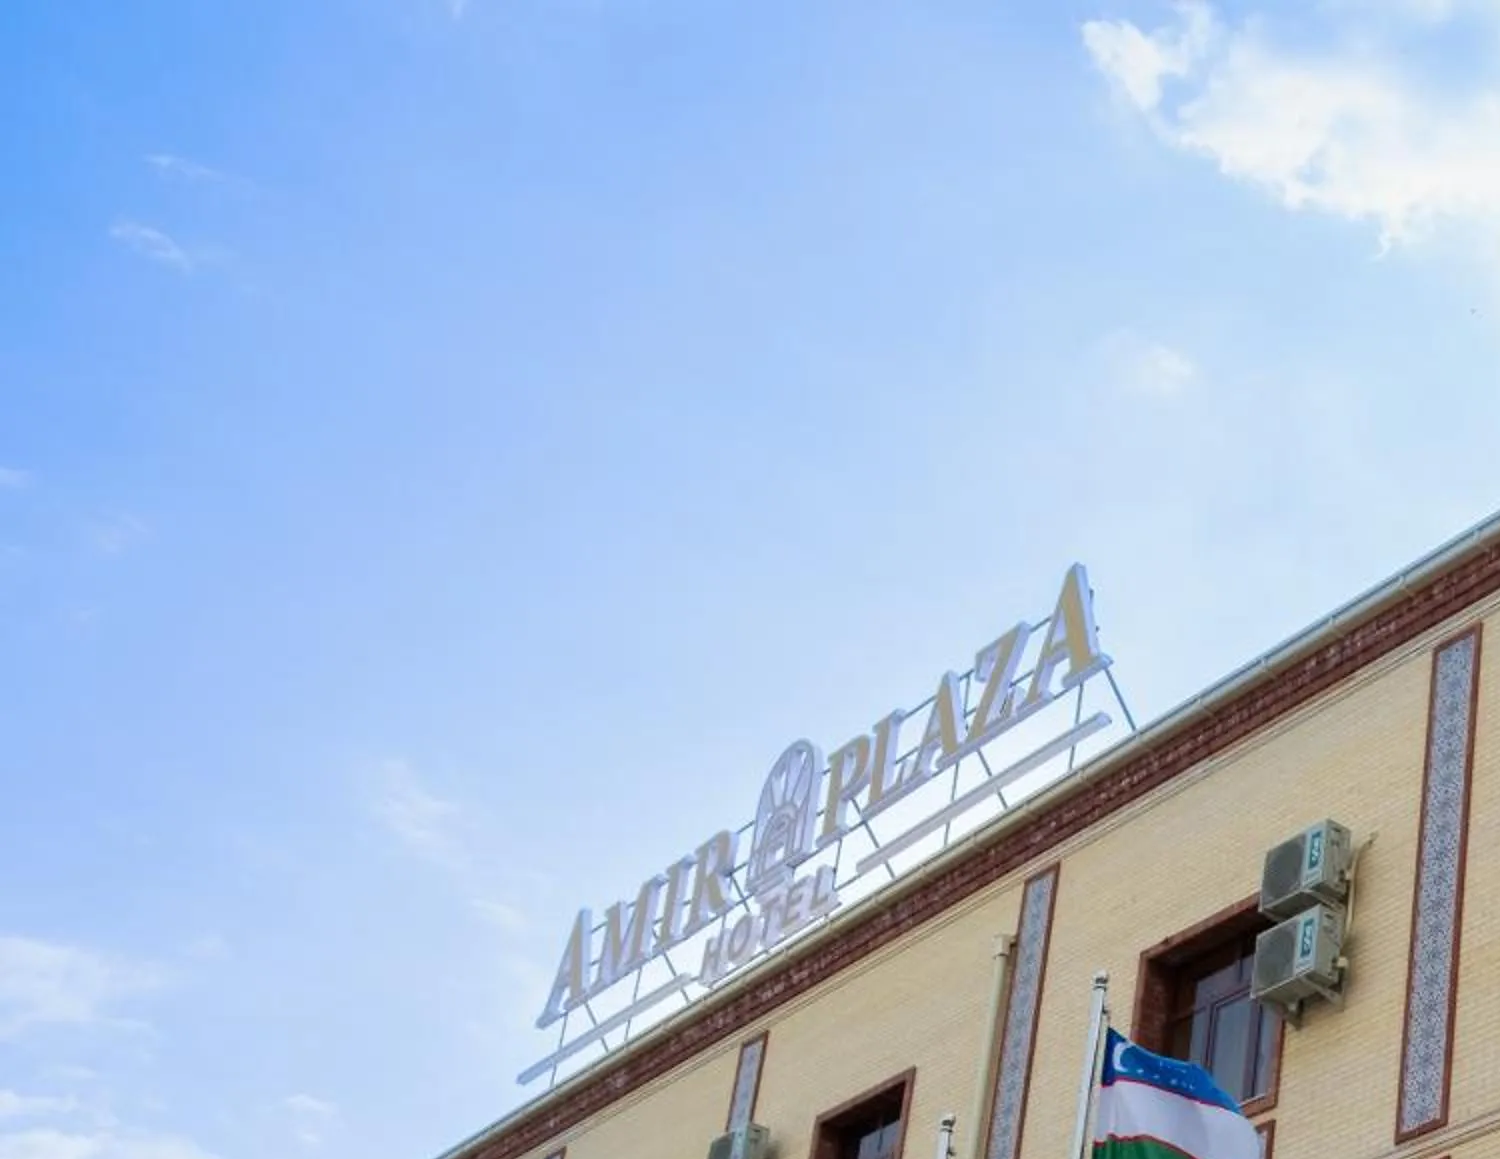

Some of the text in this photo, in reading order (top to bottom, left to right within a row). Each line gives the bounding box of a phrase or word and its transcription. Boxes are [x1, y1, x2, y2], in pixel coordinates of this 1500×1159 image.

[535, 562, 1114, 1030] AMIR PLAZA
[697, 863, 842, 989] HOTEL
